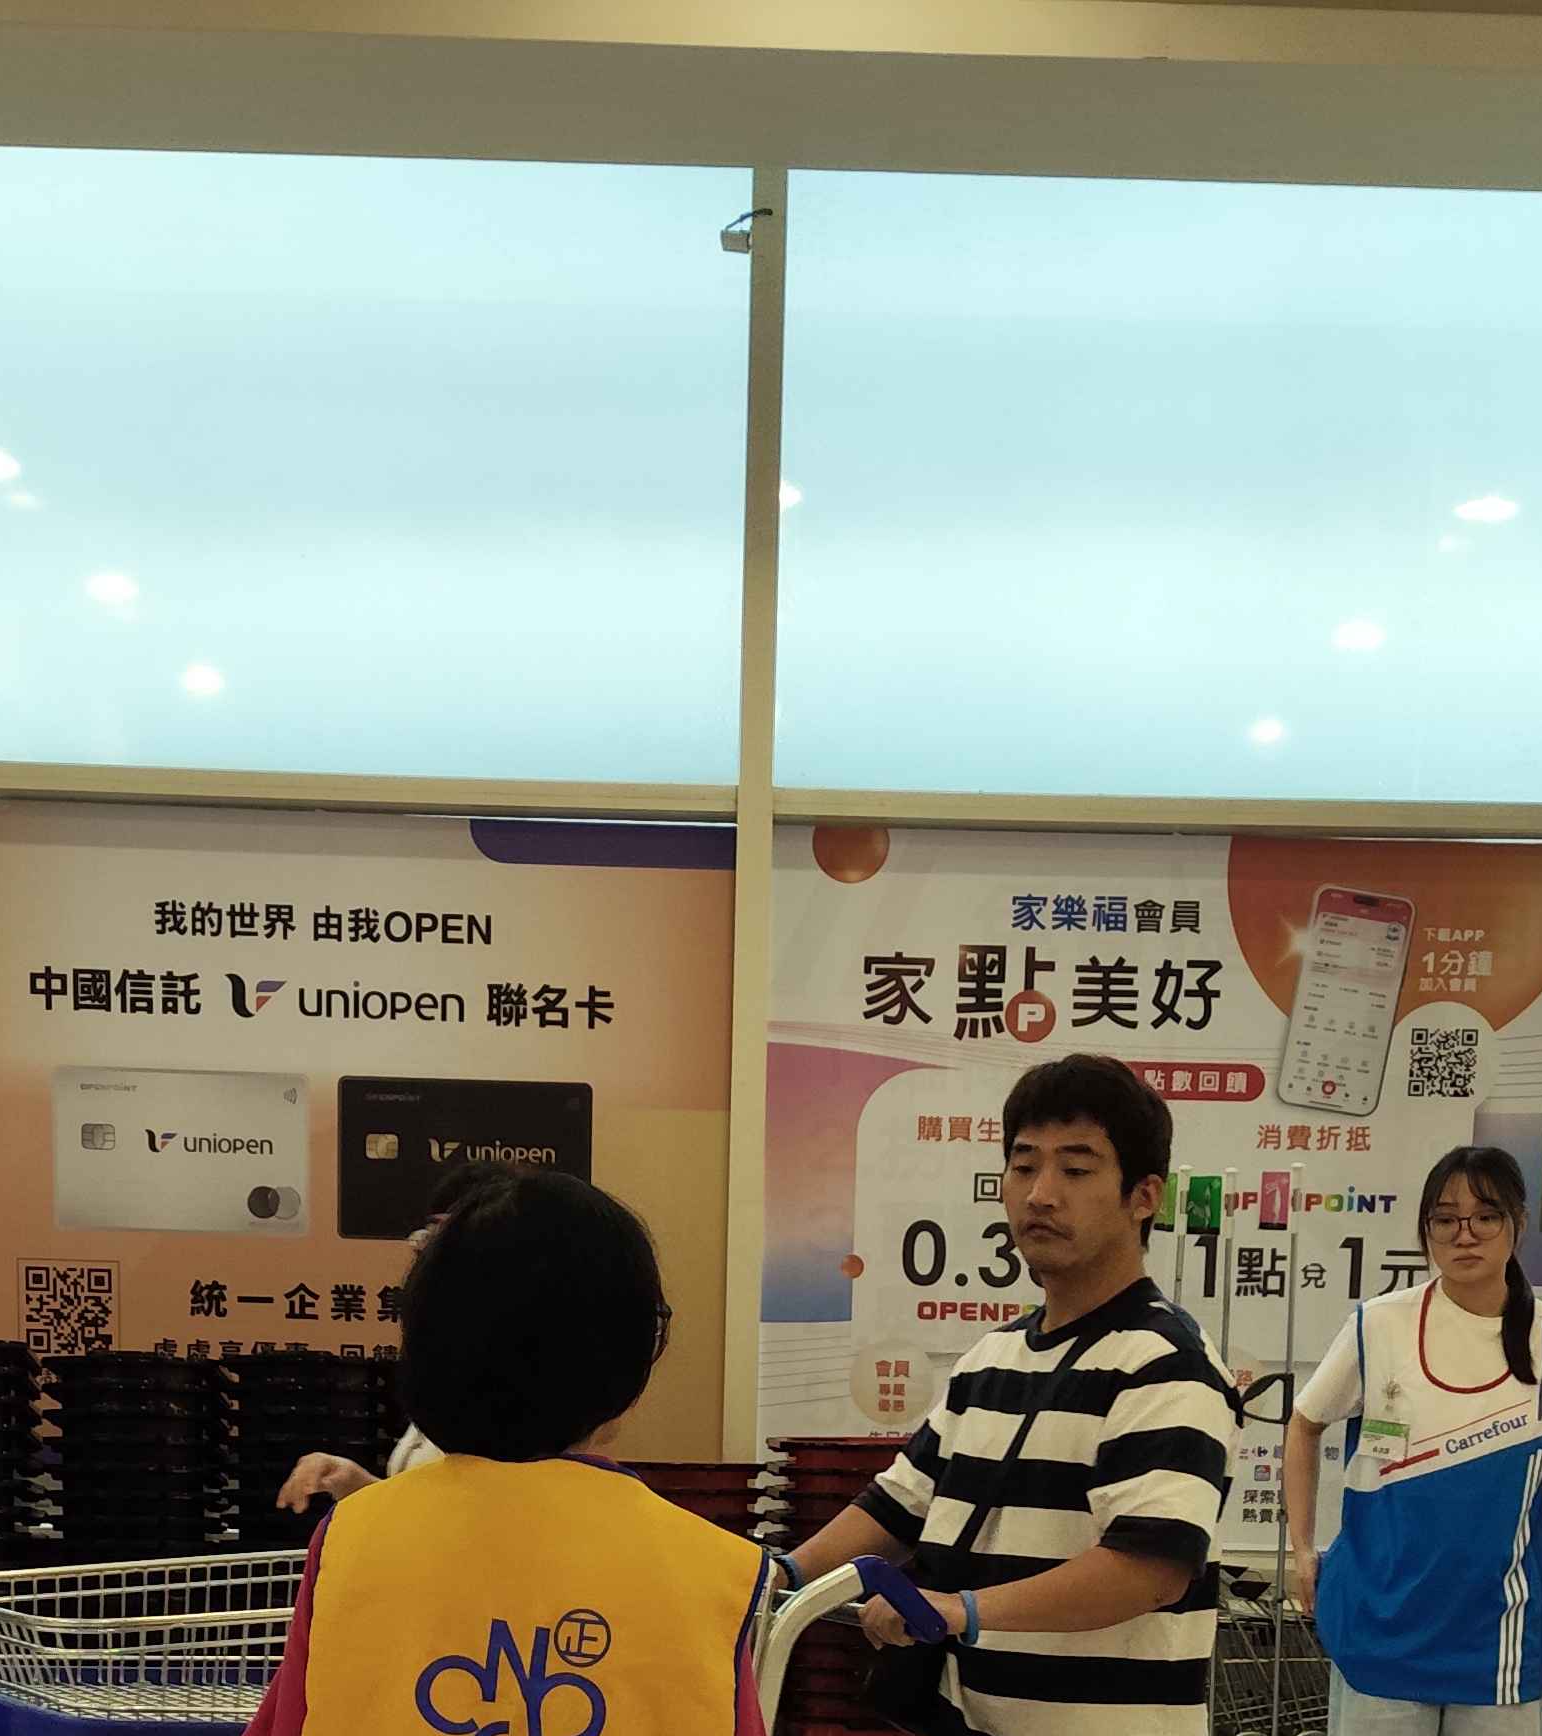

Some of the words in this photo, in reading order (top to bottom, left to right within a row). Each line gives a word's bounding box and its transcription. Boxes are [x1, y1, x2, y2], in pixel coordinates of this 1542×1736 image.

[153, 899, 297, 941] 我的世界
[311, 904, 493, 946] 由我OPEN
[1010, 892, 1202, 934] 家樂福會員
[1421, 949, 1493, 977] 1分鐘
[29, 965, 202, 1016] 中國信託
[297, 979, 465, 1024] uniopen
[485, 981, 615, 1030] 聯名卡
[183, 1132, 274, 1155] uniopen
[1256, 1124, 1372, 1152] 消費折抵
[902, 1219, 1045, 1289] 0.3
[1444, 1412, 1529, 1456] Carrefour
